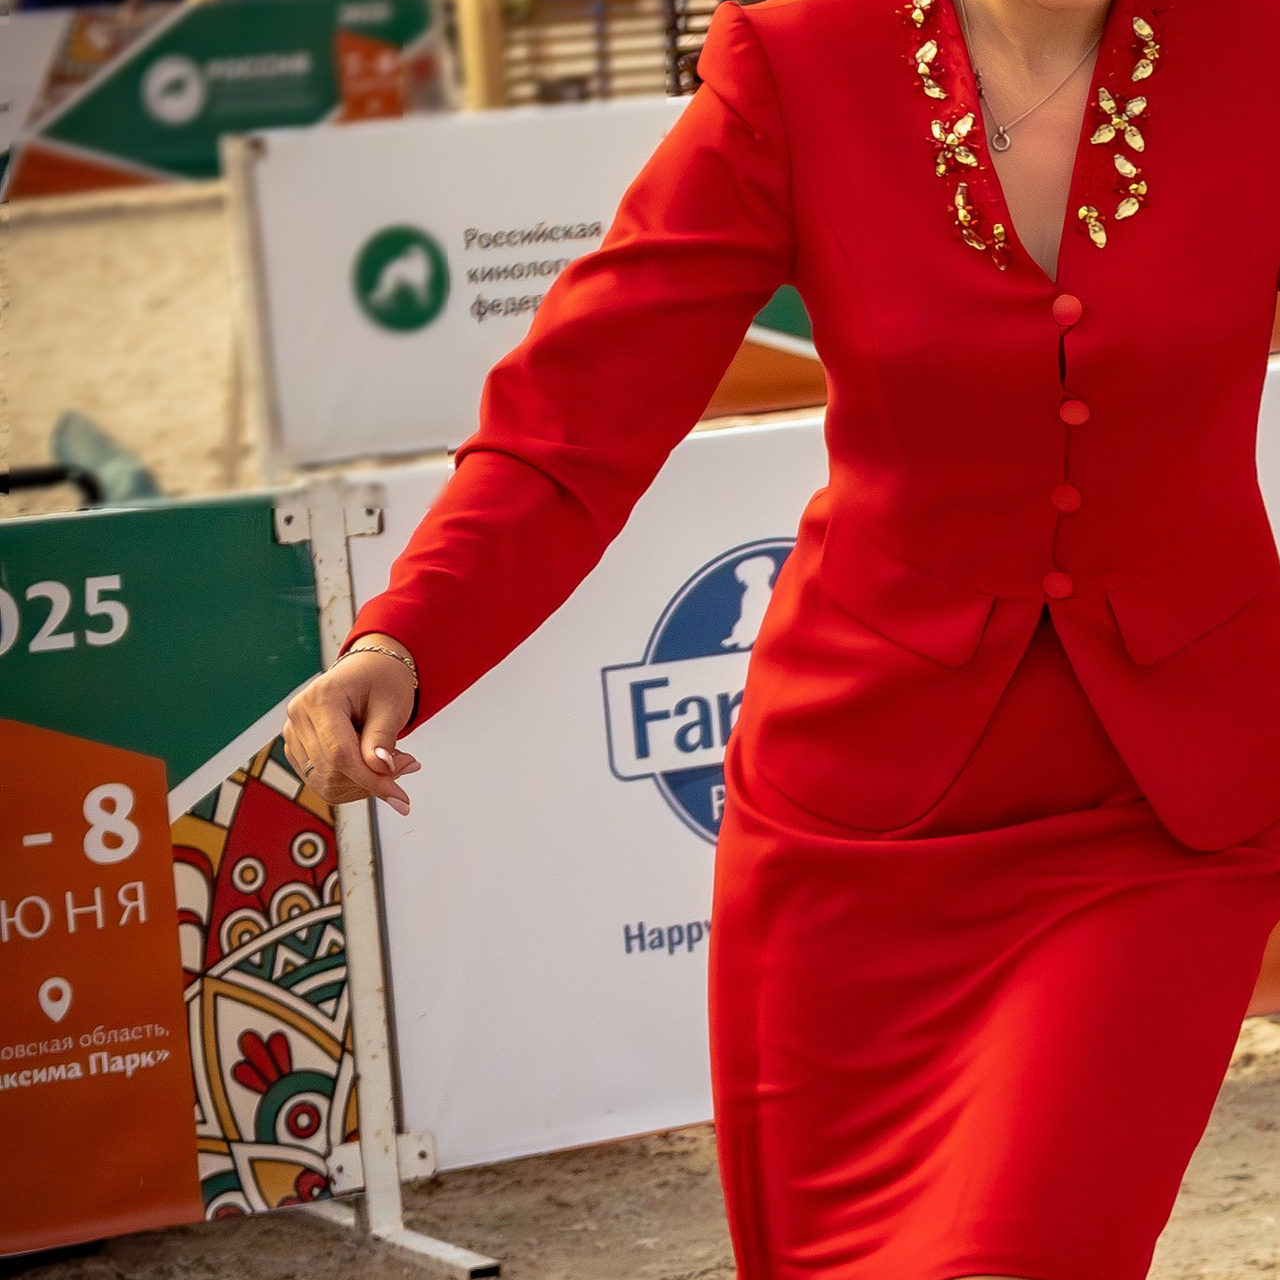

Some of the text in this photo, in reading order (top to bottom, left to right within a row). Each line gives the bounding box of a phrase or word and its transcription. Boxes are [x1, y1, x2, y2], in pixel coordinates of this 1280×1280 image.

[463, 221, 603, 250] Российская
[82, 782, 140, 865] 8
[79, 1024, 170, 1048] область,
[89, 1047, 170, 1078] Парк»
